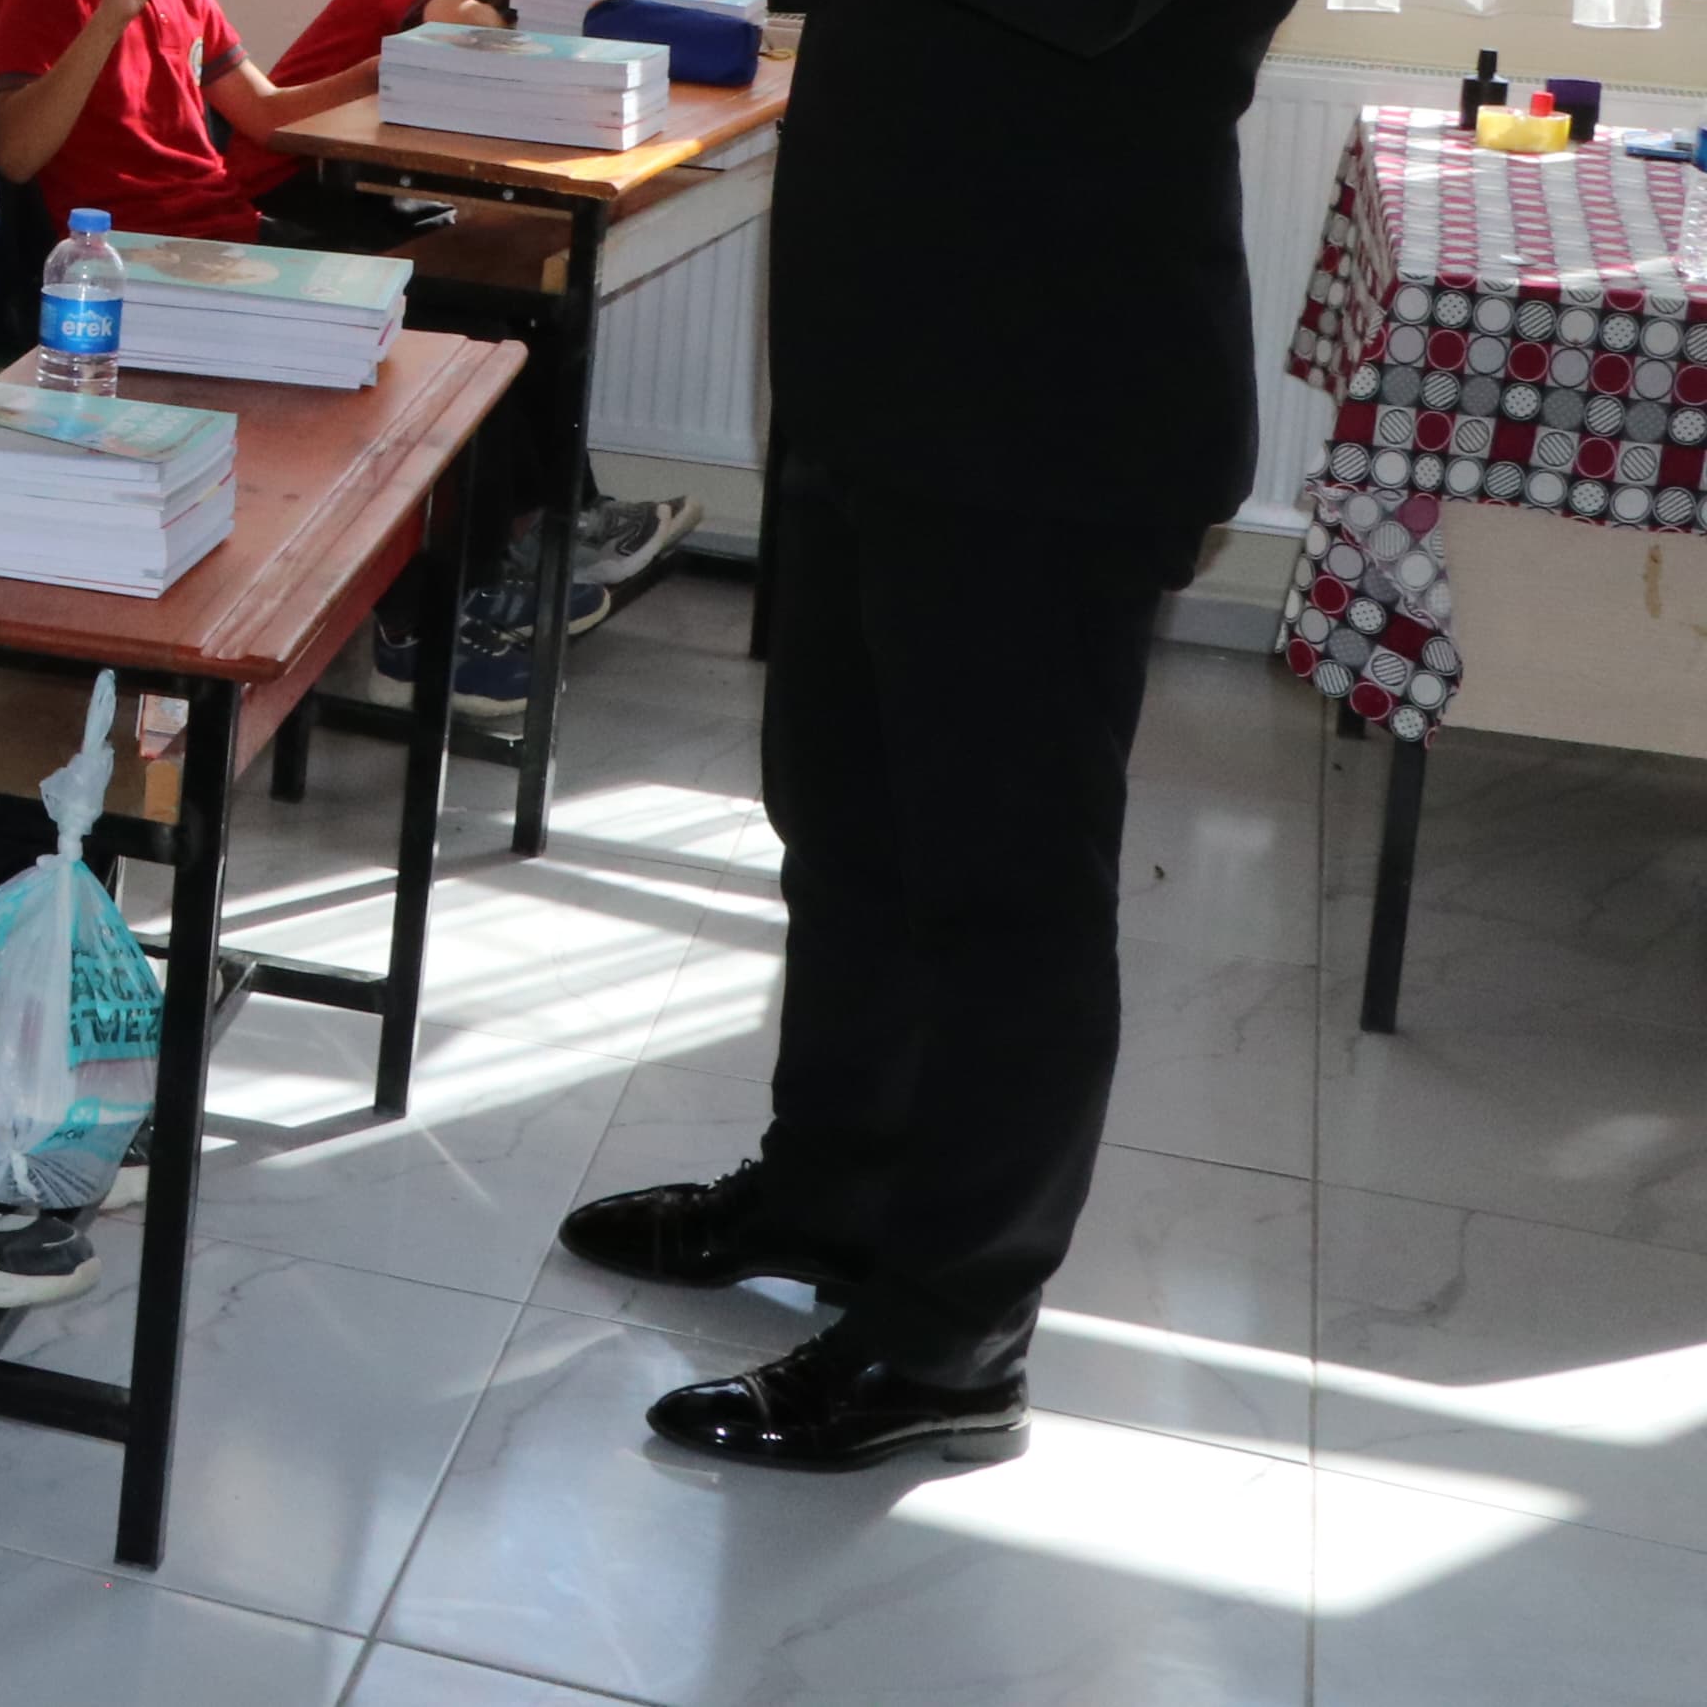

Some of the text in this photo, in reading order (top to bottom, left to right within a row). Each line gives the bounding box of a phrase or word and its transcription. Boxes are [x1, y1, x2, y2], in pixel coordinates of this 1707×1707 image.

[61, 316, 114, 338] erek
[71, 965, 159, 1003] ARCA
[69, 1006, 163, 1047] İTMEZ
